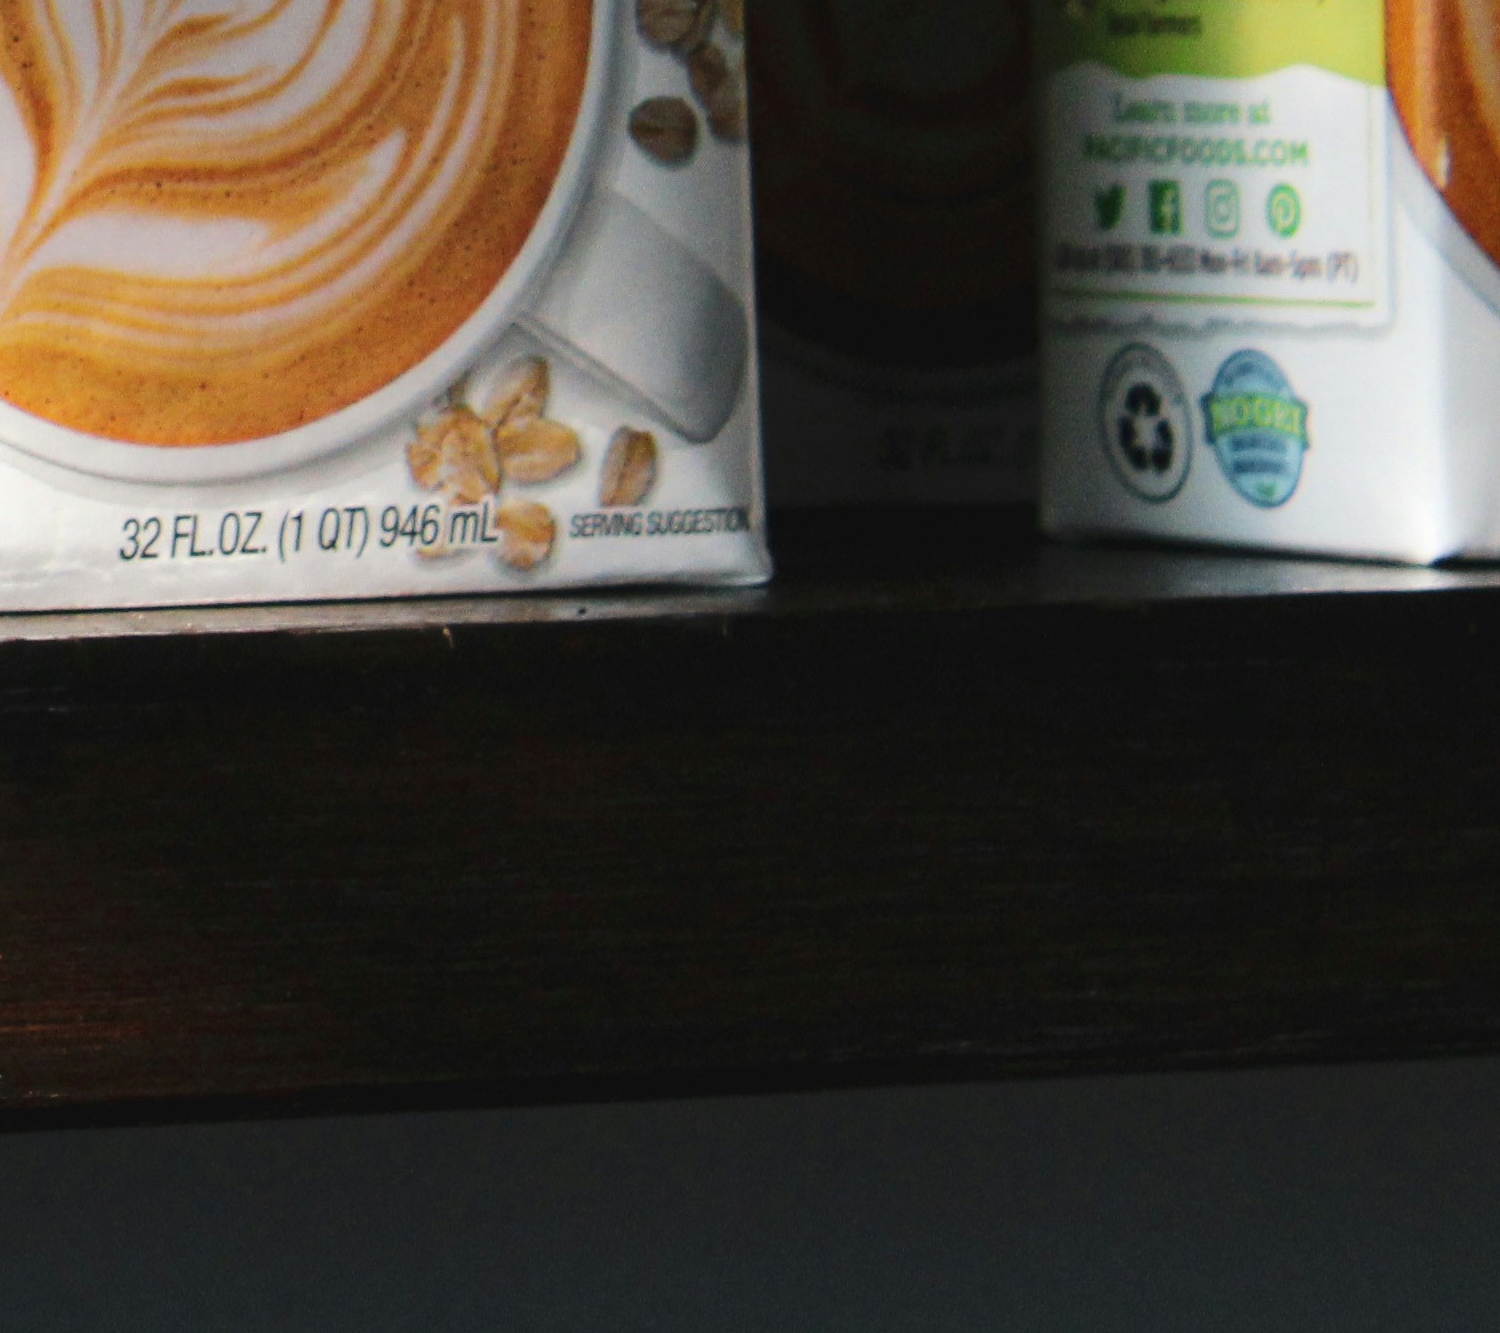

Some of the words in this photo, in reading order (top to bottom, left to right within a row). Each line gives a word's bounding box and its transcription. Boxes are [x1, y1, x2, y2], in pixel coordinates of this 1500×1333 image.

[118, 519, 163, 562] 32
[171, 515, 268, 559] FL.OZ.
[277, 515, 309, 563] (1
[318, 513, 369, 558] QT)
[378, 507, 440, 547] 946
[450, 505, 499, 546] mL
[570, 511, 643, 539] SERVING
[646, 508, 752, 537] SUGGESTION
